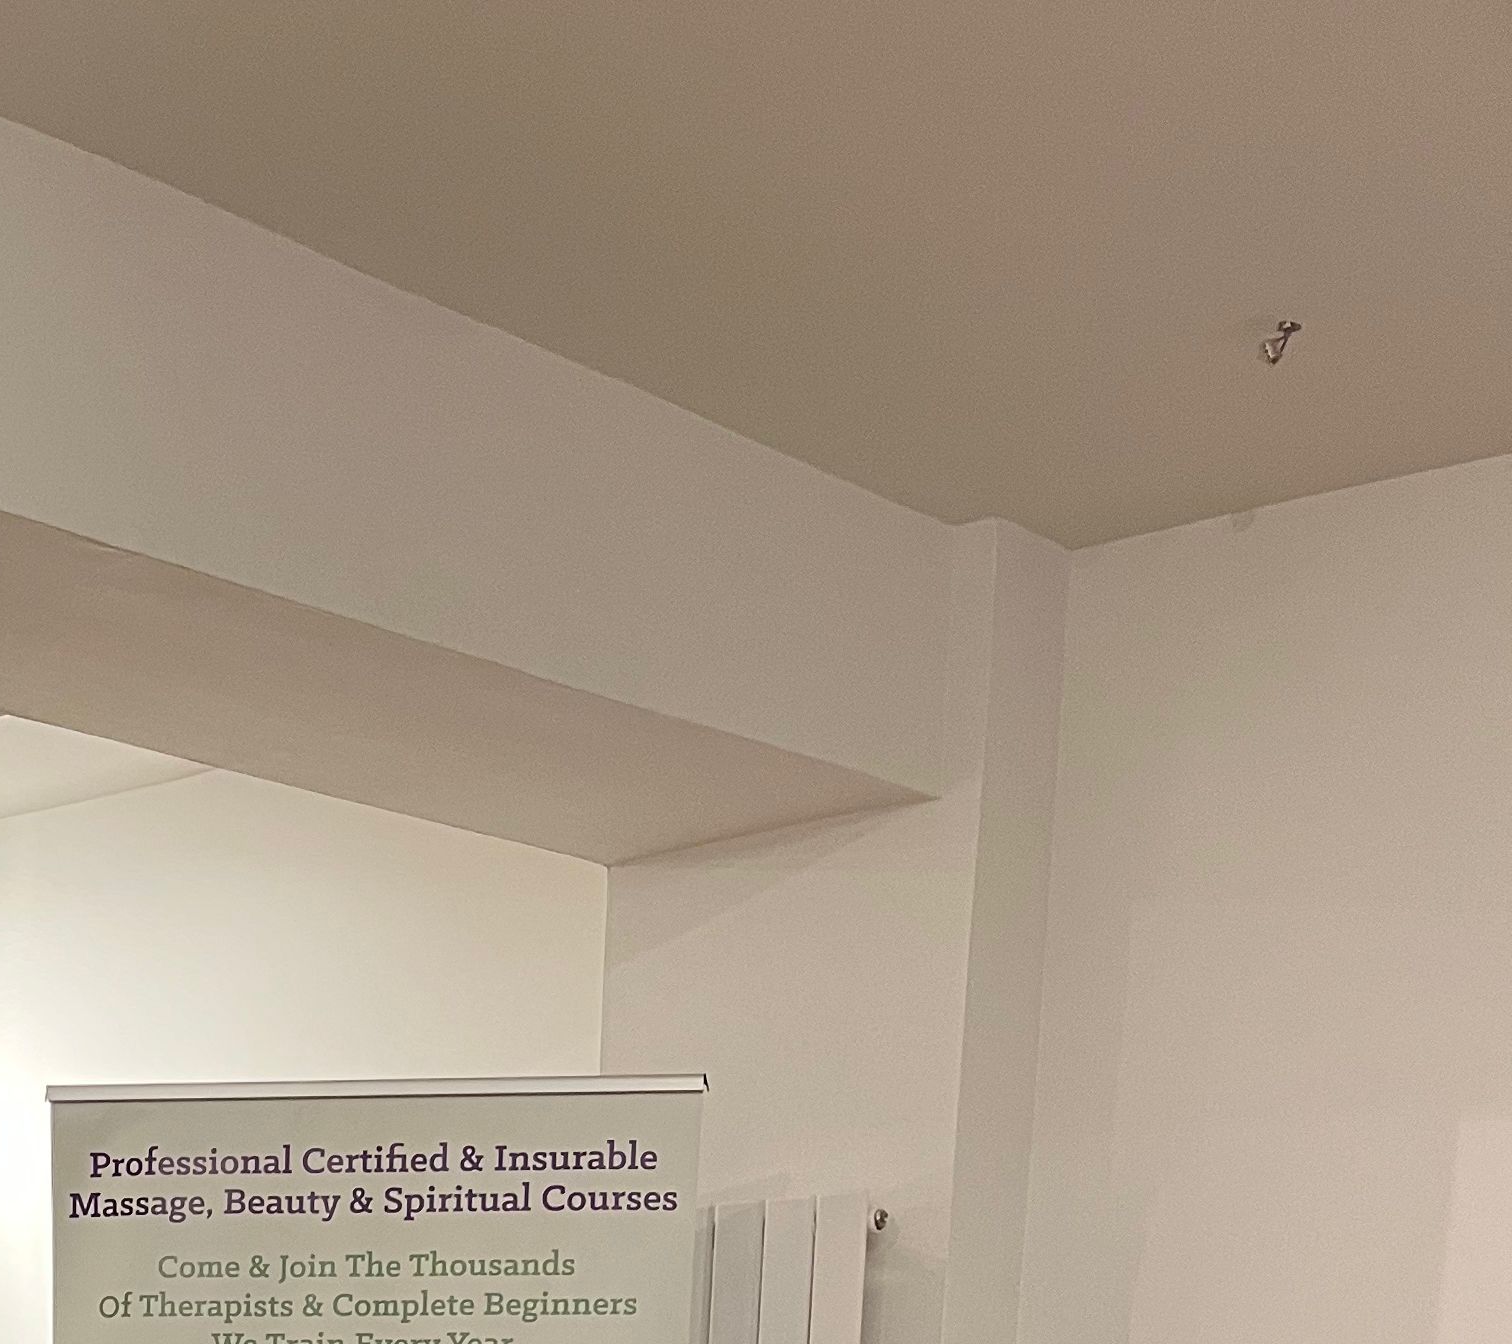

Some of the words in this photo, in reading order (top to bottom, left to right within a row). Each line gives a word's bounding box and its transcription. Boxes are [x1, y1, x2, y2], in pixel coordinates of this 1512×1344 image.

[89, 1144, 293, 1178] Professional
[302, 1141, 450, 1174] Certified
[460, 1145, 484, 1172] &
[494, 1139, 658, 1172] Insurable
[68, 1192, 213, 1224] Massage,
[223, 1188, 341, 1222] Beauty
[349, 1187, 374, 1214] &
[384, 1181, 532, 1221] Spiritual
[542, 1184, 678, 1212] Courses
[158, 1255, 240, 1279] Come
[248, 1254, 271, 1278] &
[278, 1253, 338, 1285] Join
[345, 1250, 401, 1278] The
[408, 1248, 575, 1277] Thousands
[98, 1291, 133, 1319] Of
[138, 1291, 293, 1324] Therapists
[302, 1293, 324, 1317] &
[332, 1289, 475, 1324] Complete
[483, 1290, 637, 1323] Beginners
